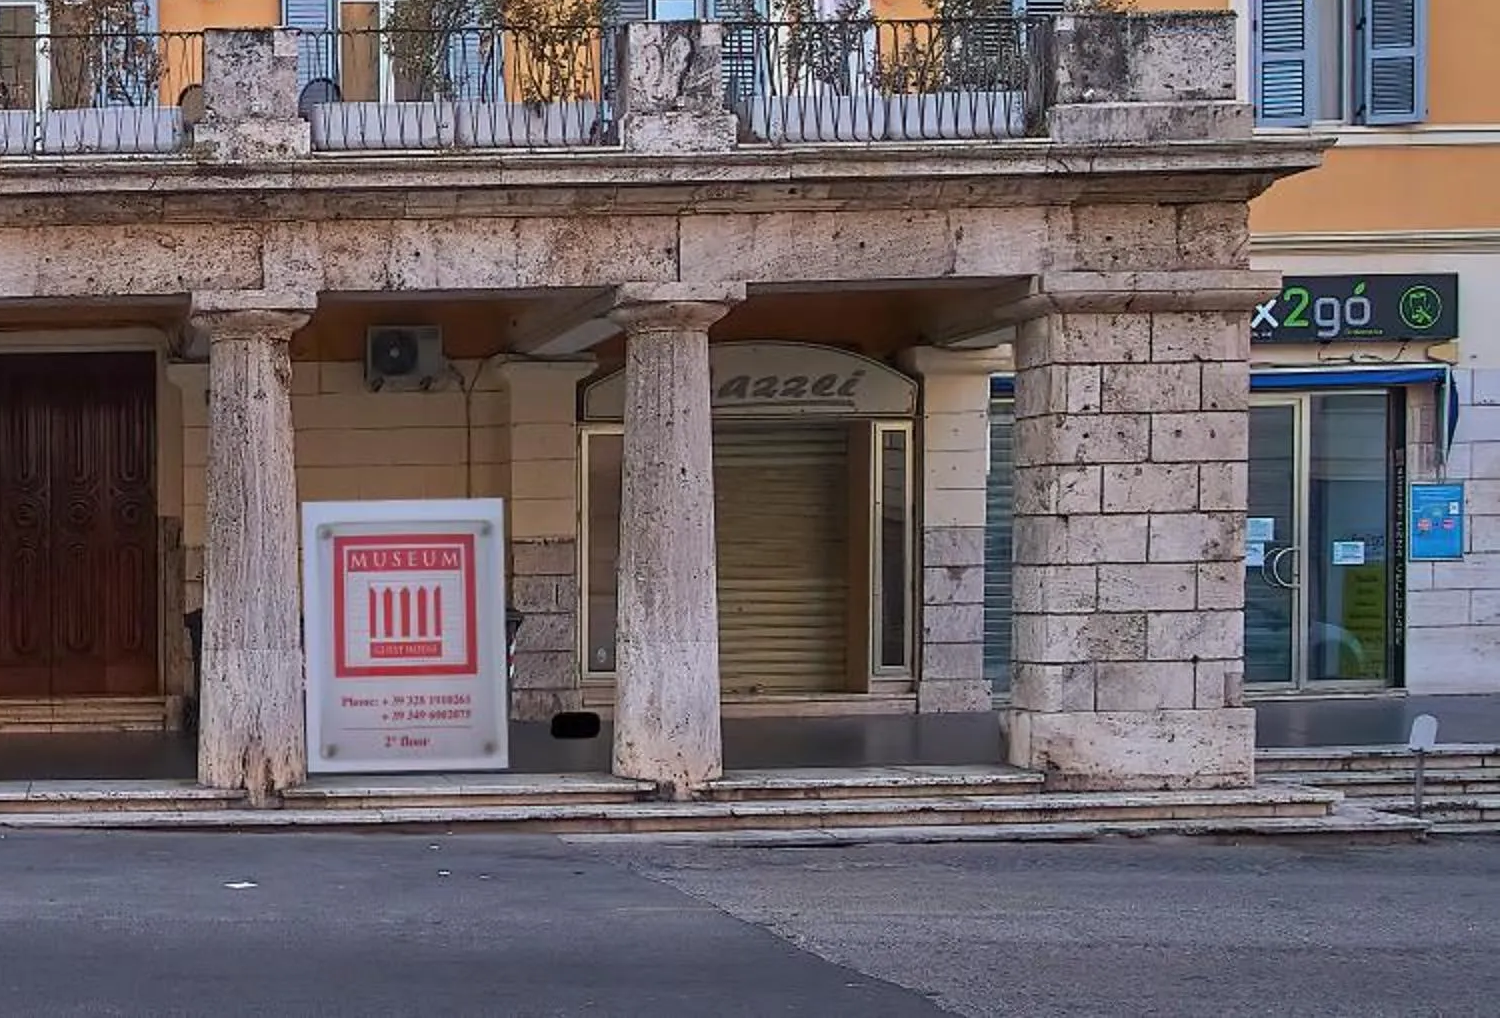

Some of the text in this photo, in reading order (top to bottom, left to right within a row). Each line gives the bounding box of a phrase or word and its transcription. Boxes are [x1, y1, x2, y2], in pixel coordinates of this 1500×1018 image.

[717, 369, 867, 399] azzei
[350, 549, 459, 568] MUSEUM
[400, 735, 431, 747] floor
